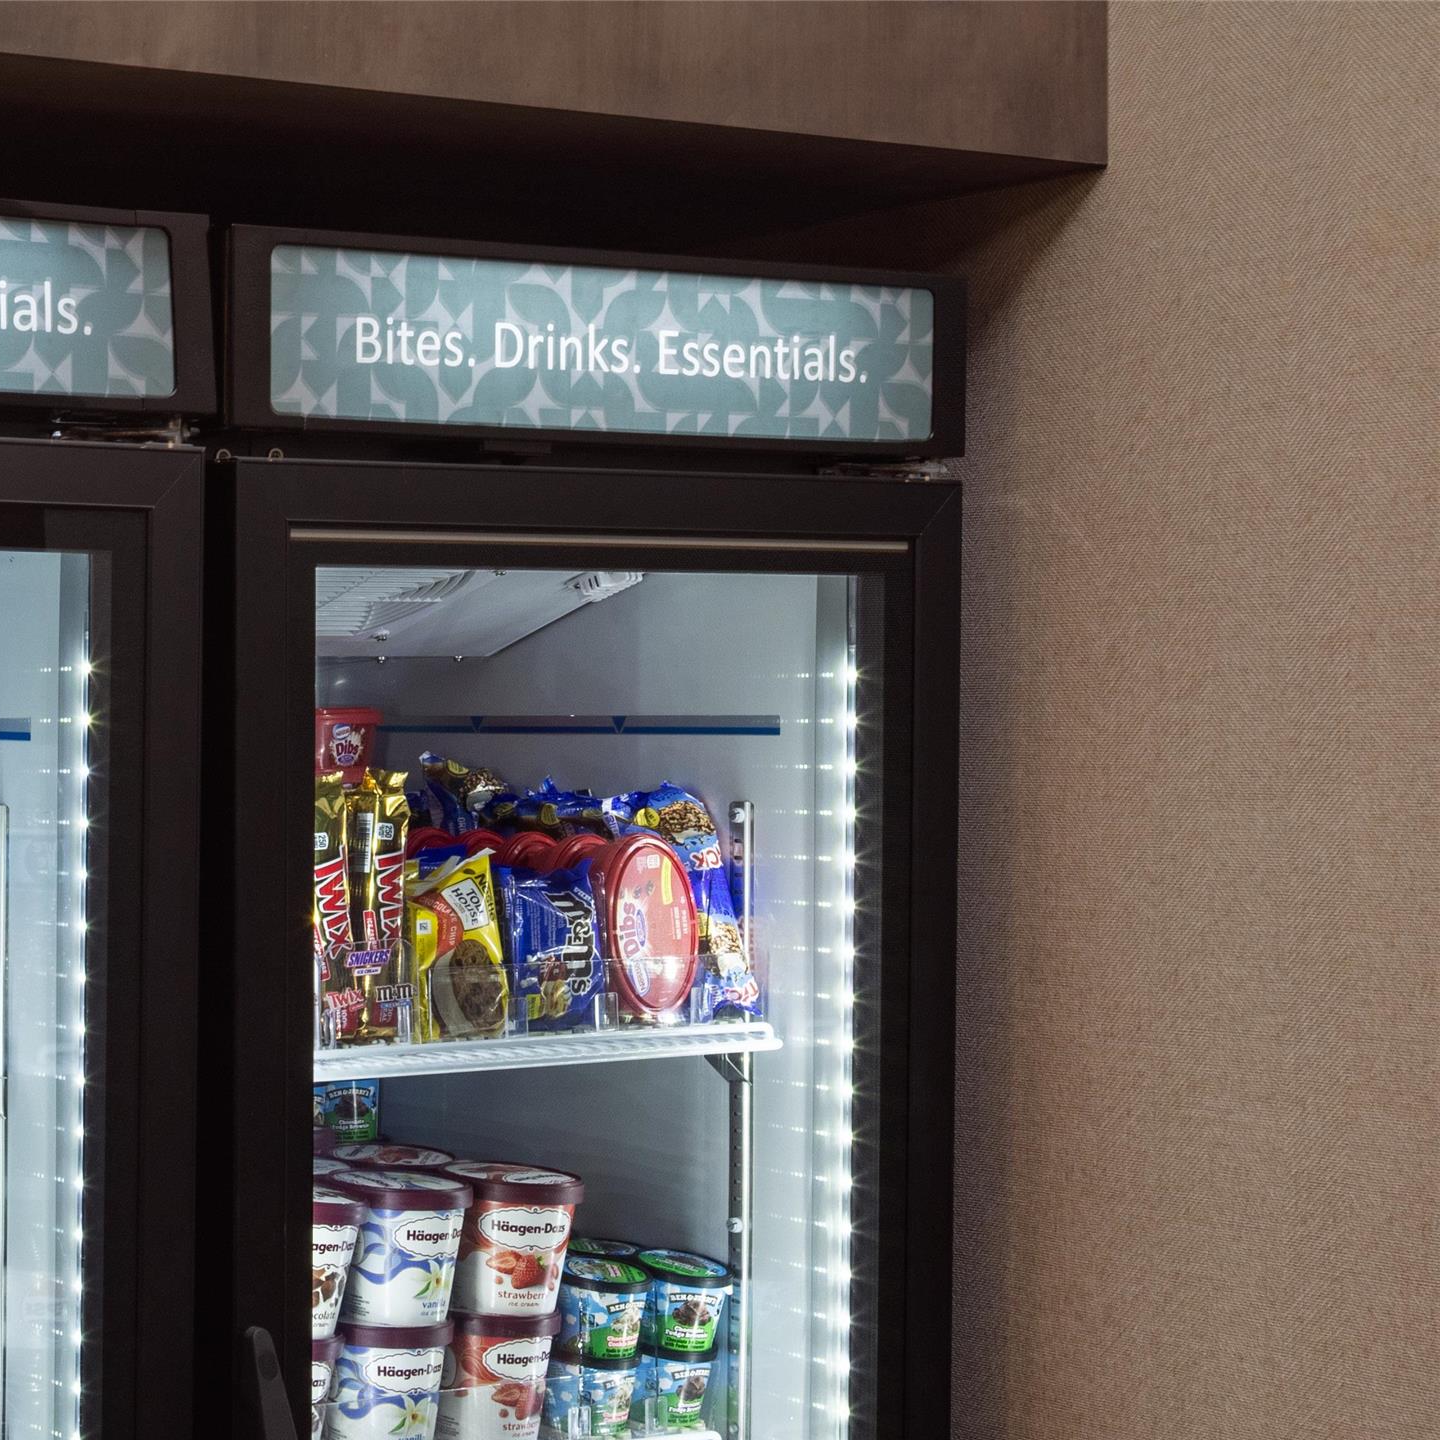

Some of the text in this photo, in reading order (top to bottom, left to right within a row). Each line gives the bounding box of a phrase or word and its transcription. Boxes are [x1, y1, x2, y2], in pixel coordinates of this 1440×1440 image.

[355, 316, 868, 384] Bites. Drinks. Essentials.
[335, 739, 359, 758] Dibs
[451, 887, 480, 927] HOUSE
[467, 887, 484, 914] TOLL
[347, 948, 391, 968] SNICKERS
[491, 1219, 566, 1236] Häagen-Dazs
